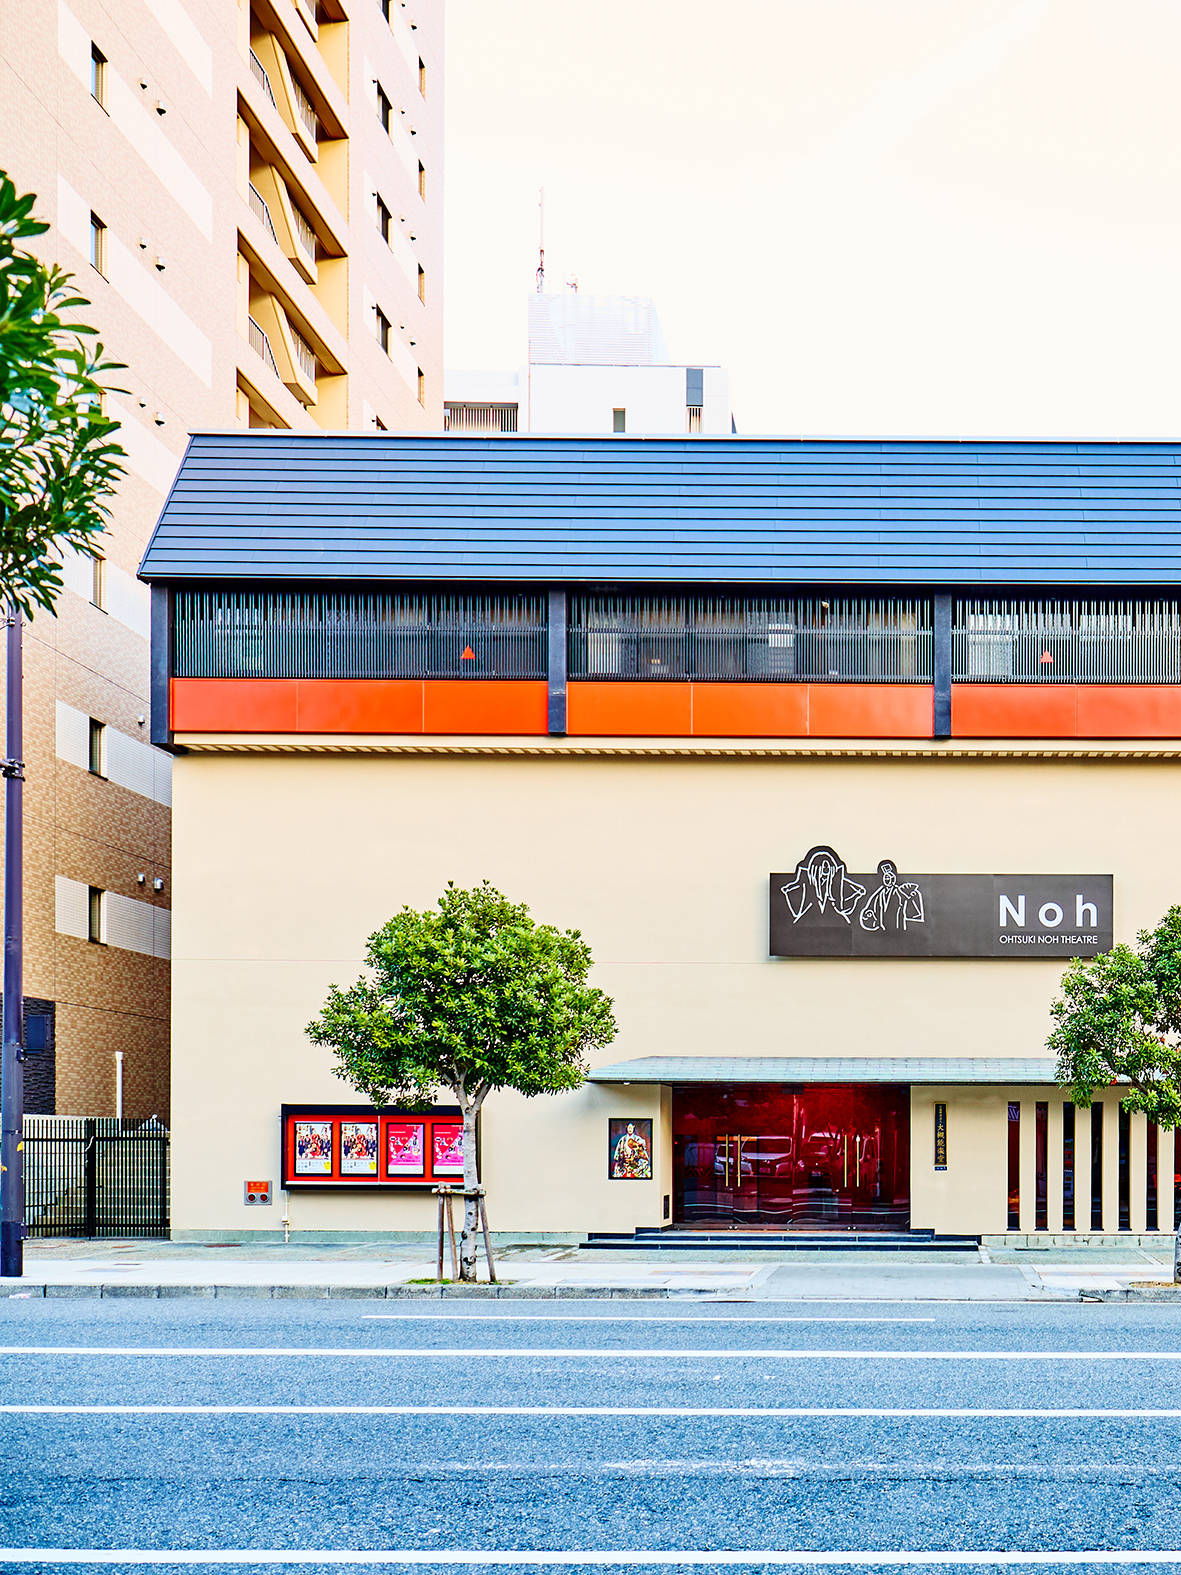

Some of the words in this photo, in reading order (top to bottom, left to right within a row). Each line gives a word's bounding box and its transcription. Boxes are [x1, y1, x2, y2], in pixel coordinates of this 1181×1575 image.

[1000, 894, 1098, 927] Noh
[999, 935, 1036, 944] OHTSUKI
[1037, 935, 1059, 944] NOH
[1060, 935, 1098, 944] THEATRE
